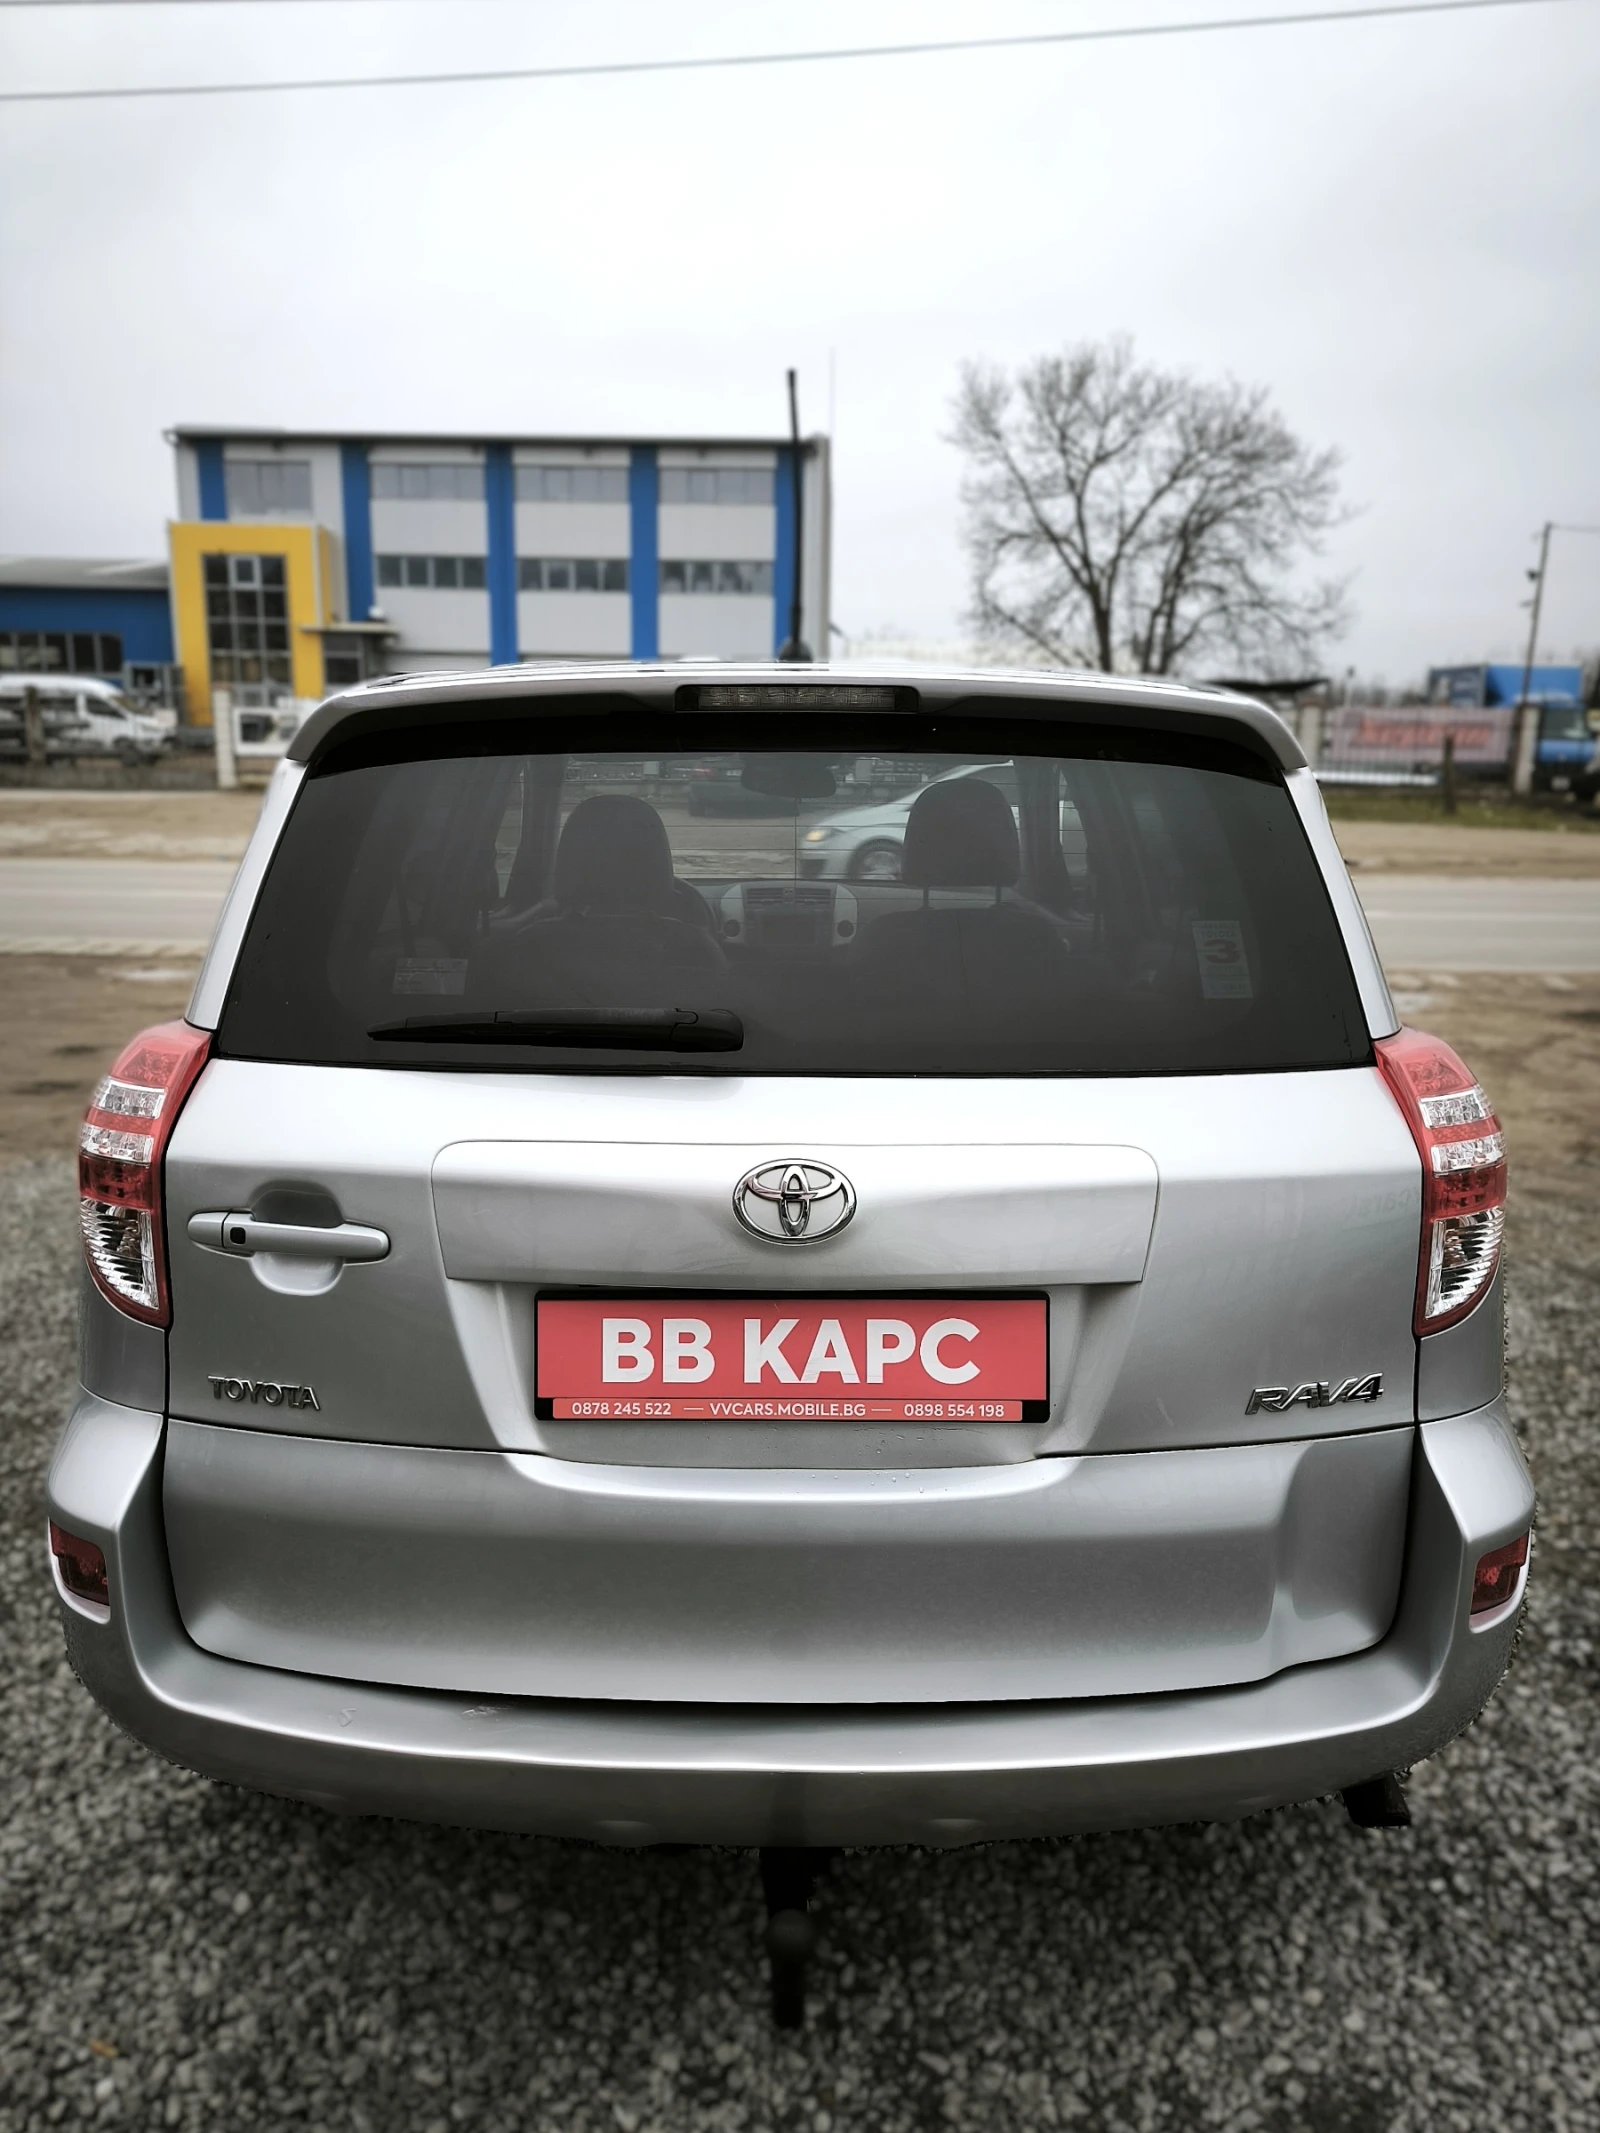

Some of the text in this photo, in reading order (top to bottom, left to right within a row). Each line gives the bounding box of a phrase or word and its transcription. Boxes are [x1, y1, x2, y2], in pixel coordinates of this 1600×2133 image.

[207, 1374, 320, 1411] TOYOTA
[571, 1402, 1005, 1418] 0878 245 522 VVCARS.MOBILE.BG 0898 554 198
[1245, 1372, 1384, 1415] RAV4
